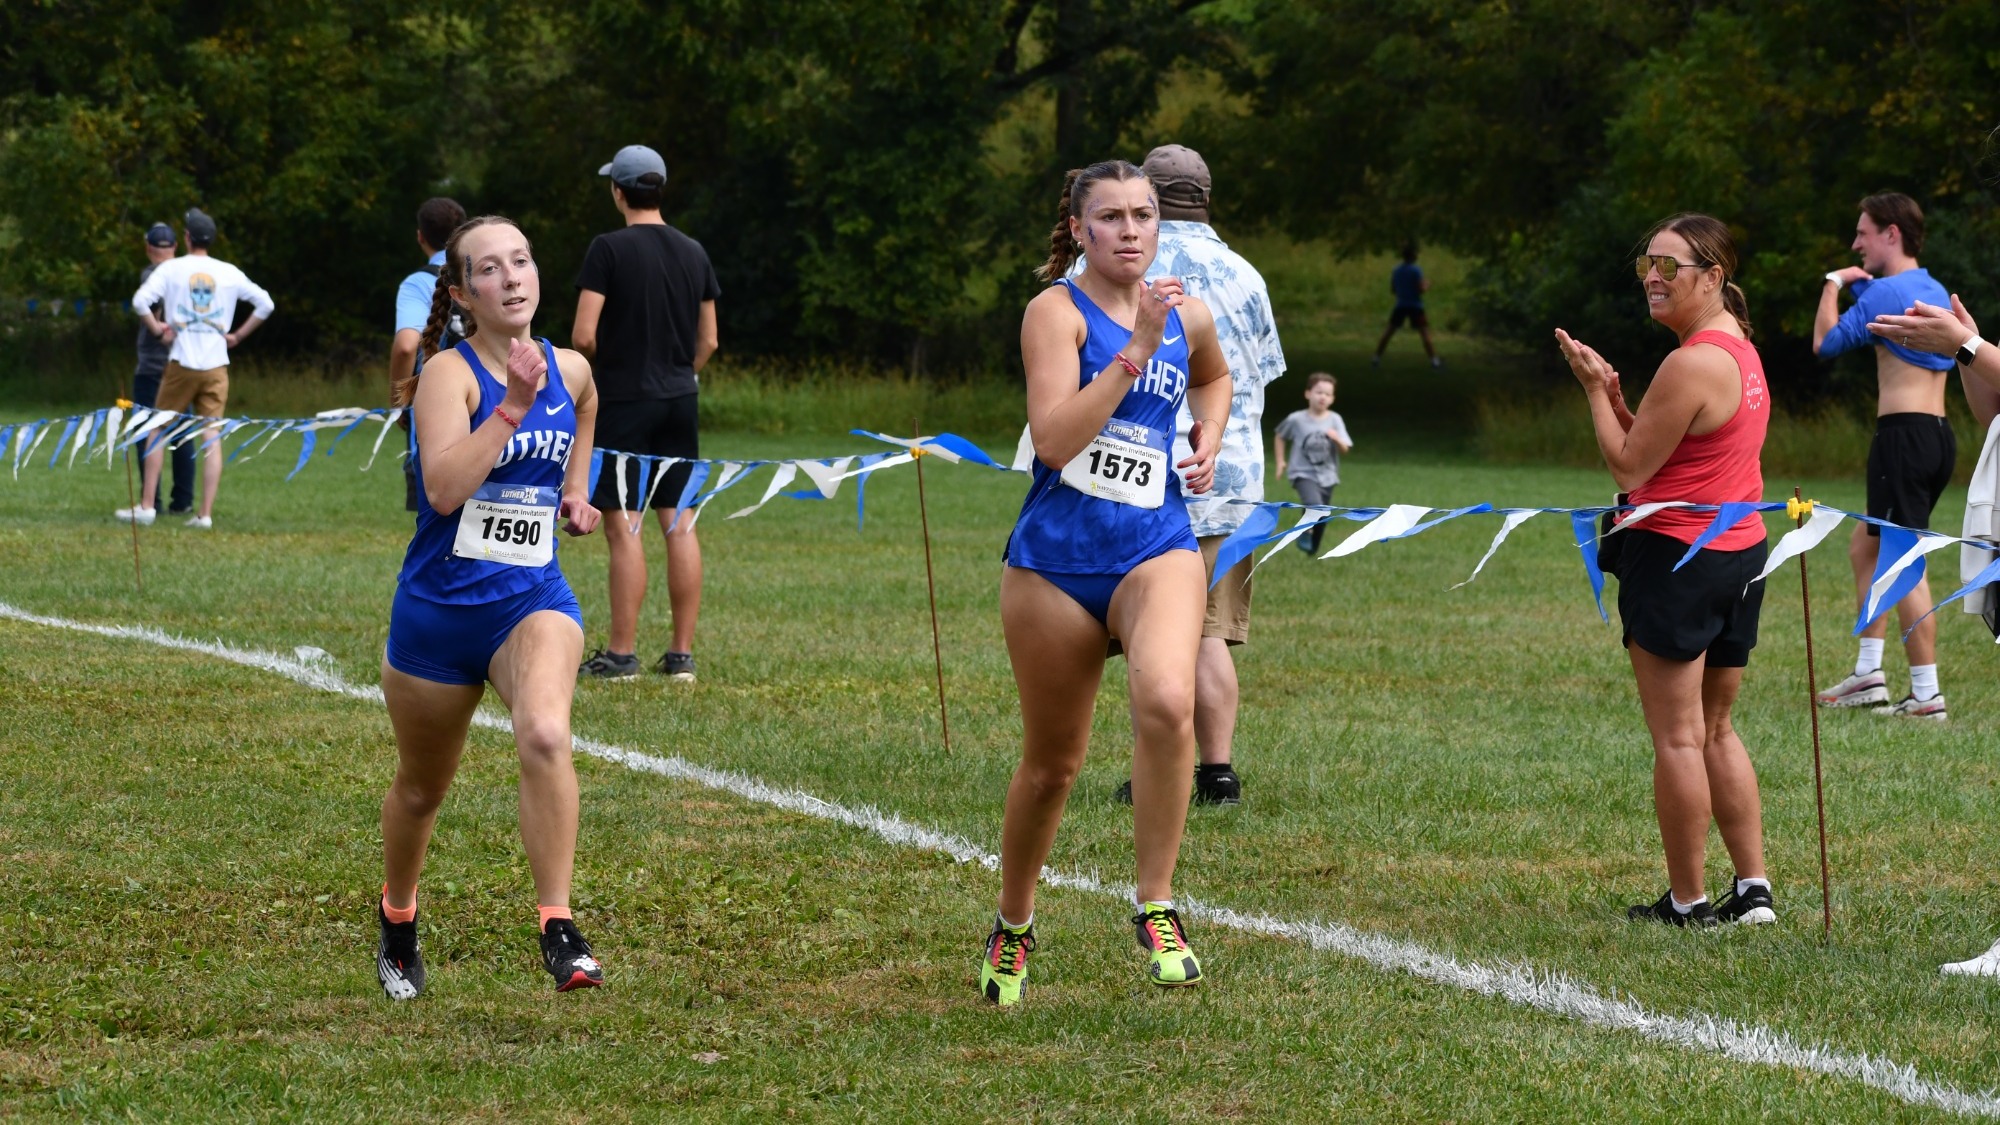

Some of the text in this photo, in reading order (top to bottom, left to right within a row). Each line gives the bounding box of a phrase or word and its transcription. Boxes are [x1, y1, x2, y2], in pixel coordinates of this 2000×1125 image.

[1092, 359, 1186, 410] HER
[1108, 424, 1149, 444] LUTHER XC
[493, 430, 575, 472] UTHER
[1091, 439, 1161, 460] -American Invitational
[1089, 449, 1152, 487] 1573
[501, 488, 539, 504] LUTHER XC
[475, 504, 548, 517] All-American Invitational
[482, 516, 541, 546] 1590
